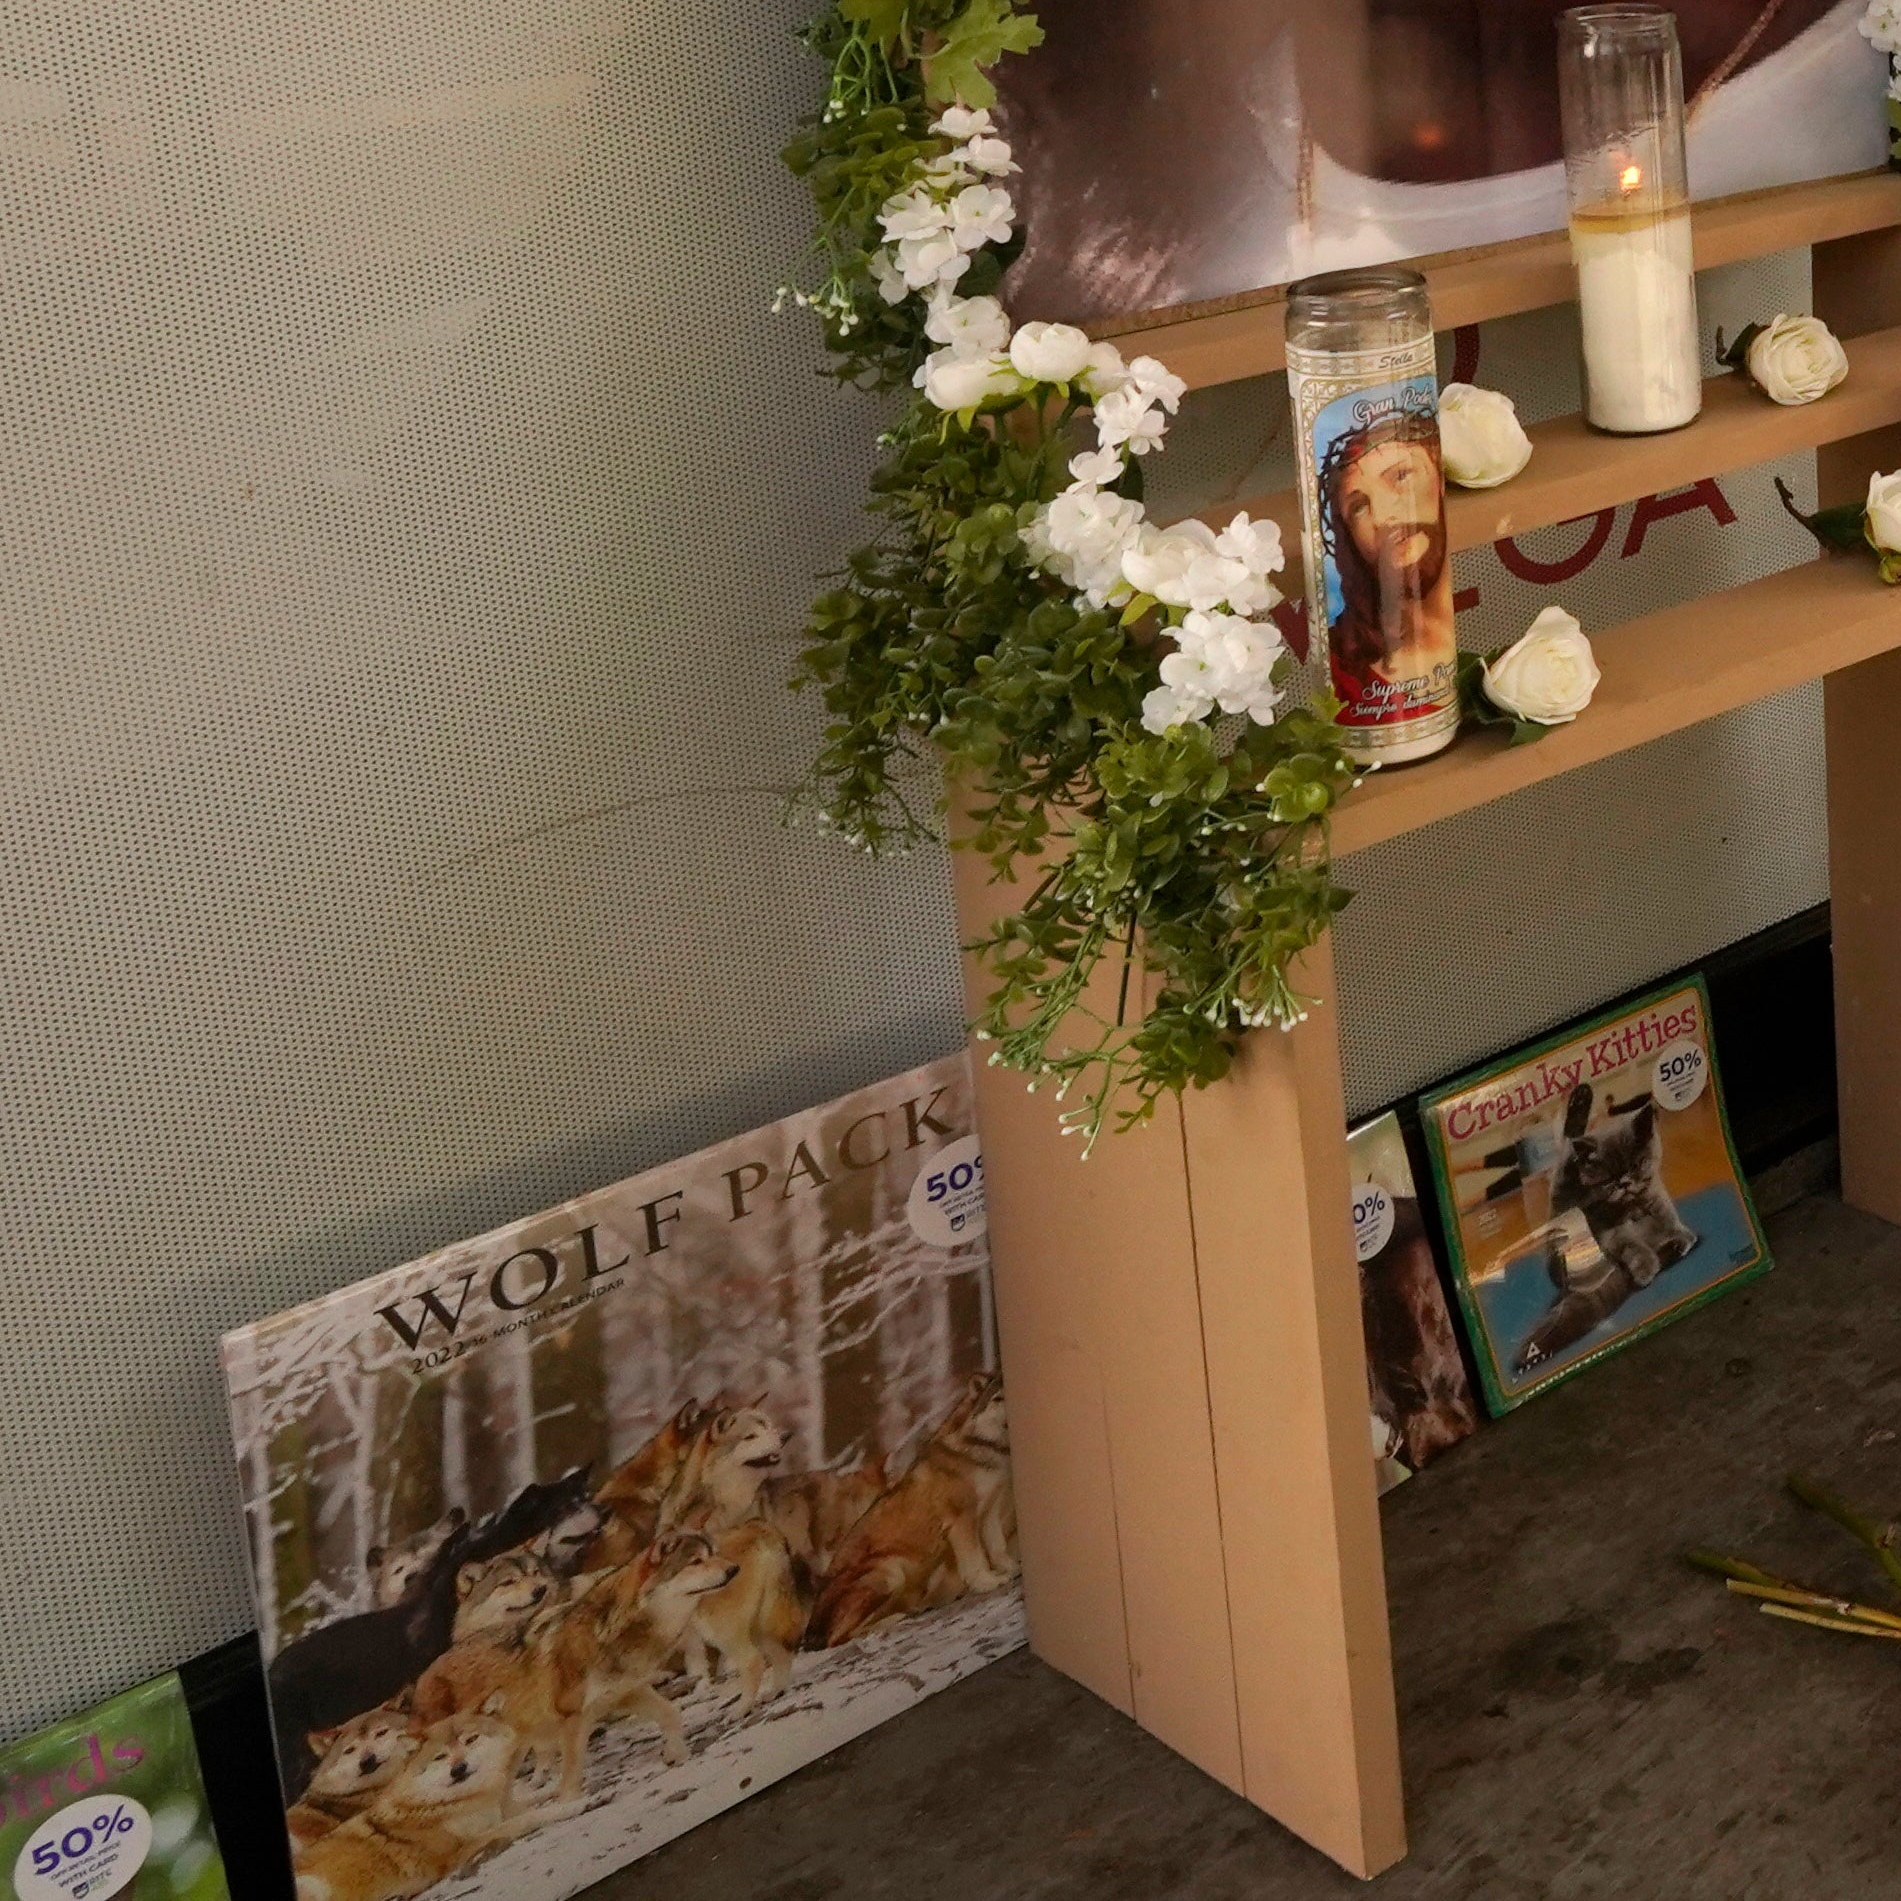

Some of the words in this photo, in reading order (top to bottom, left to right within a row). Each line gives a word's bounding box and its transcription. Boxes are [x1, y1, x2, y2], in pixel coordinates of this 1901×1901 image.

[1447, 1059, 1583, 1141] Cranky
[1586, 1003, 1698, 1078] Kitties
[1659, 1048, 1702, 1083] 50%
[373, 1190, 685, 1351] WOLF
[723, 1087, 954, 1222] PACK
[412, 1340, 465, 1375] 2022
[0, 1733, 145, 1827] irds
[32, 1803, 135, 1876] 50%
